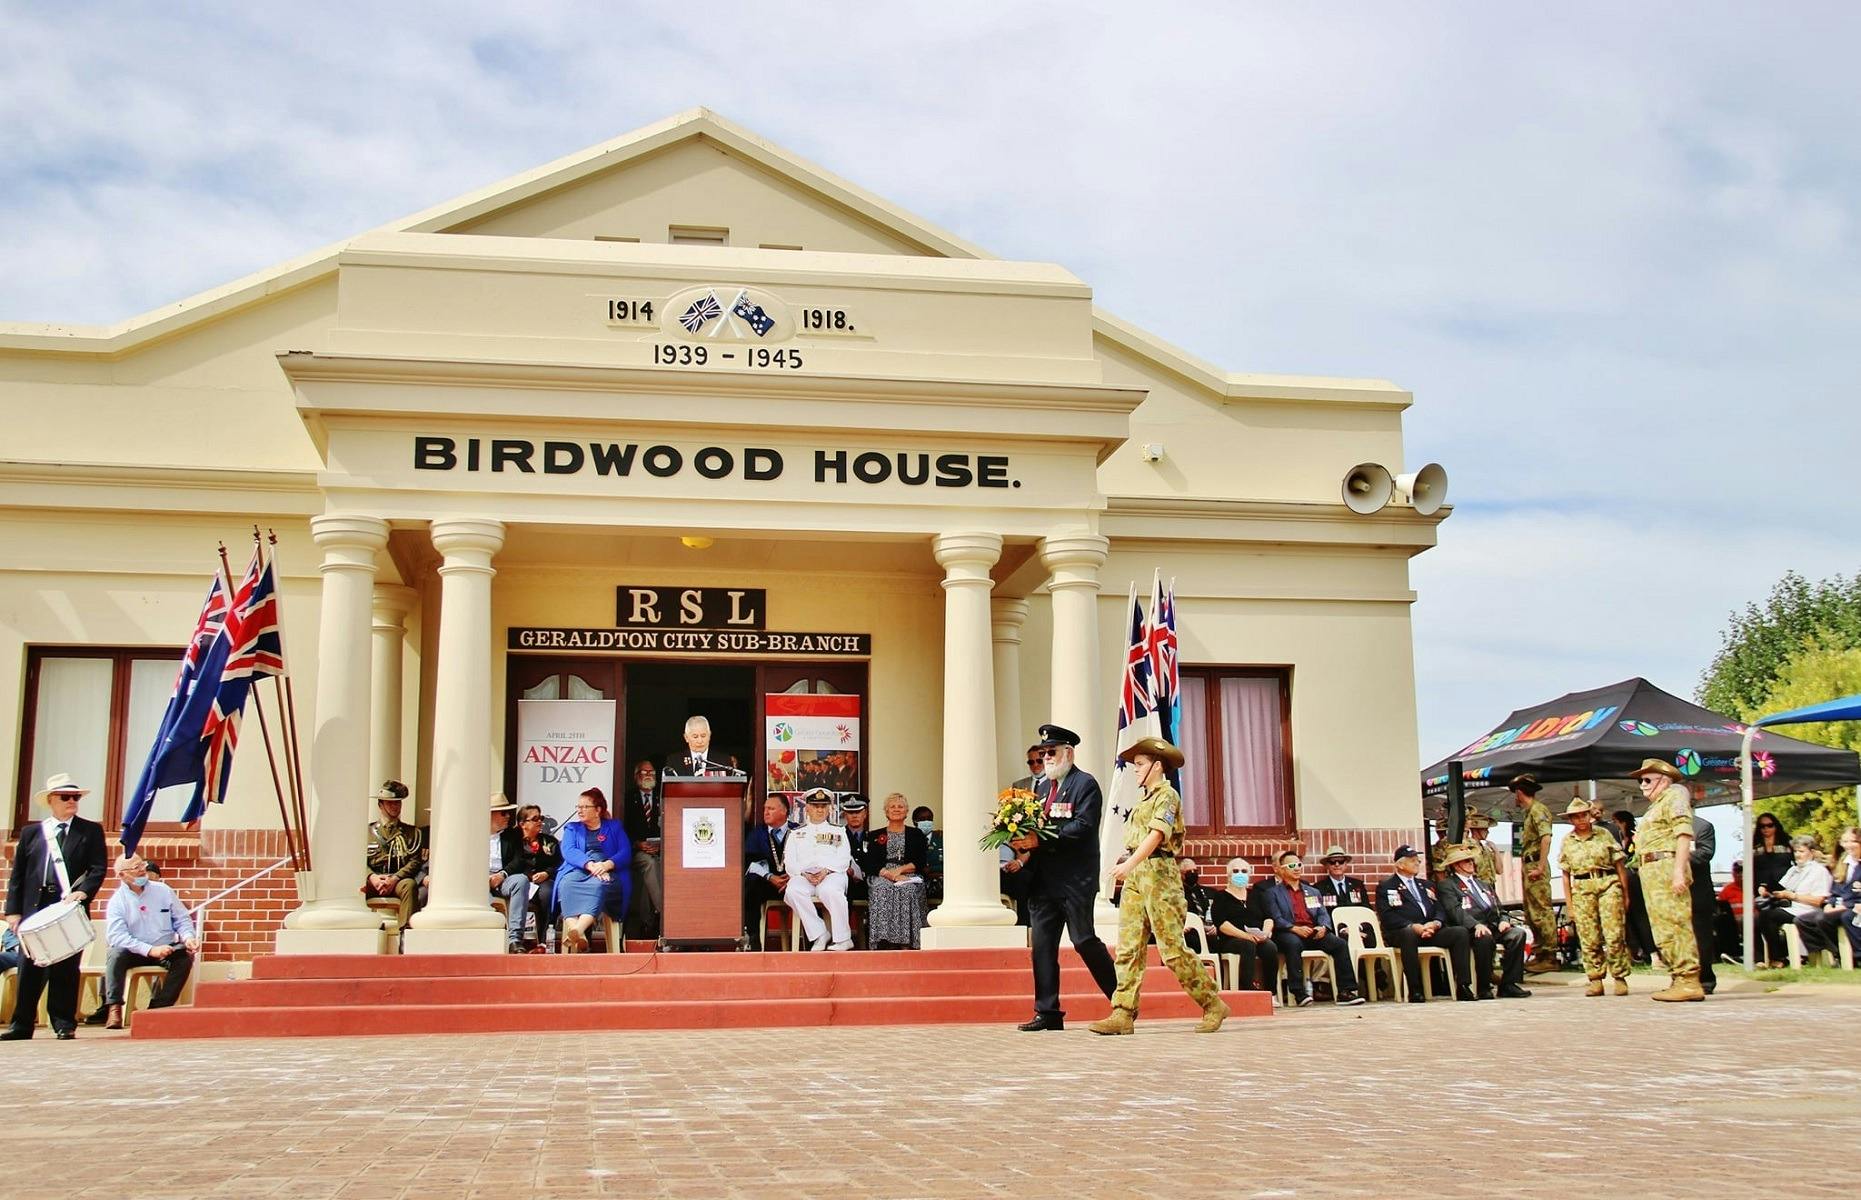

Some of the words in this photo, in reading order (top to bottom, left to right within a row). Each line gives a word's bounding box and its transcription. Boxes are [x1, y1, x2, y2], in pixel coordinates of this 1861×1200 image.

[608, 299, 654, 321] 1914
[654, 344, 708, 366] 1939
[748, 348, 803, 369] 1945
[414, 436, 785, 481] BIRDWOOD
[814, 449, 1022, 489] HOUSE.
[519, 630, 658, 649] GERALDTON
[662, 632, 713, 650] CITY
[717, 633, 861, 652] SUB-BRANCH
[522, 745, 608, 764] ANZAC
[540, 765, 589, 784] DAY
